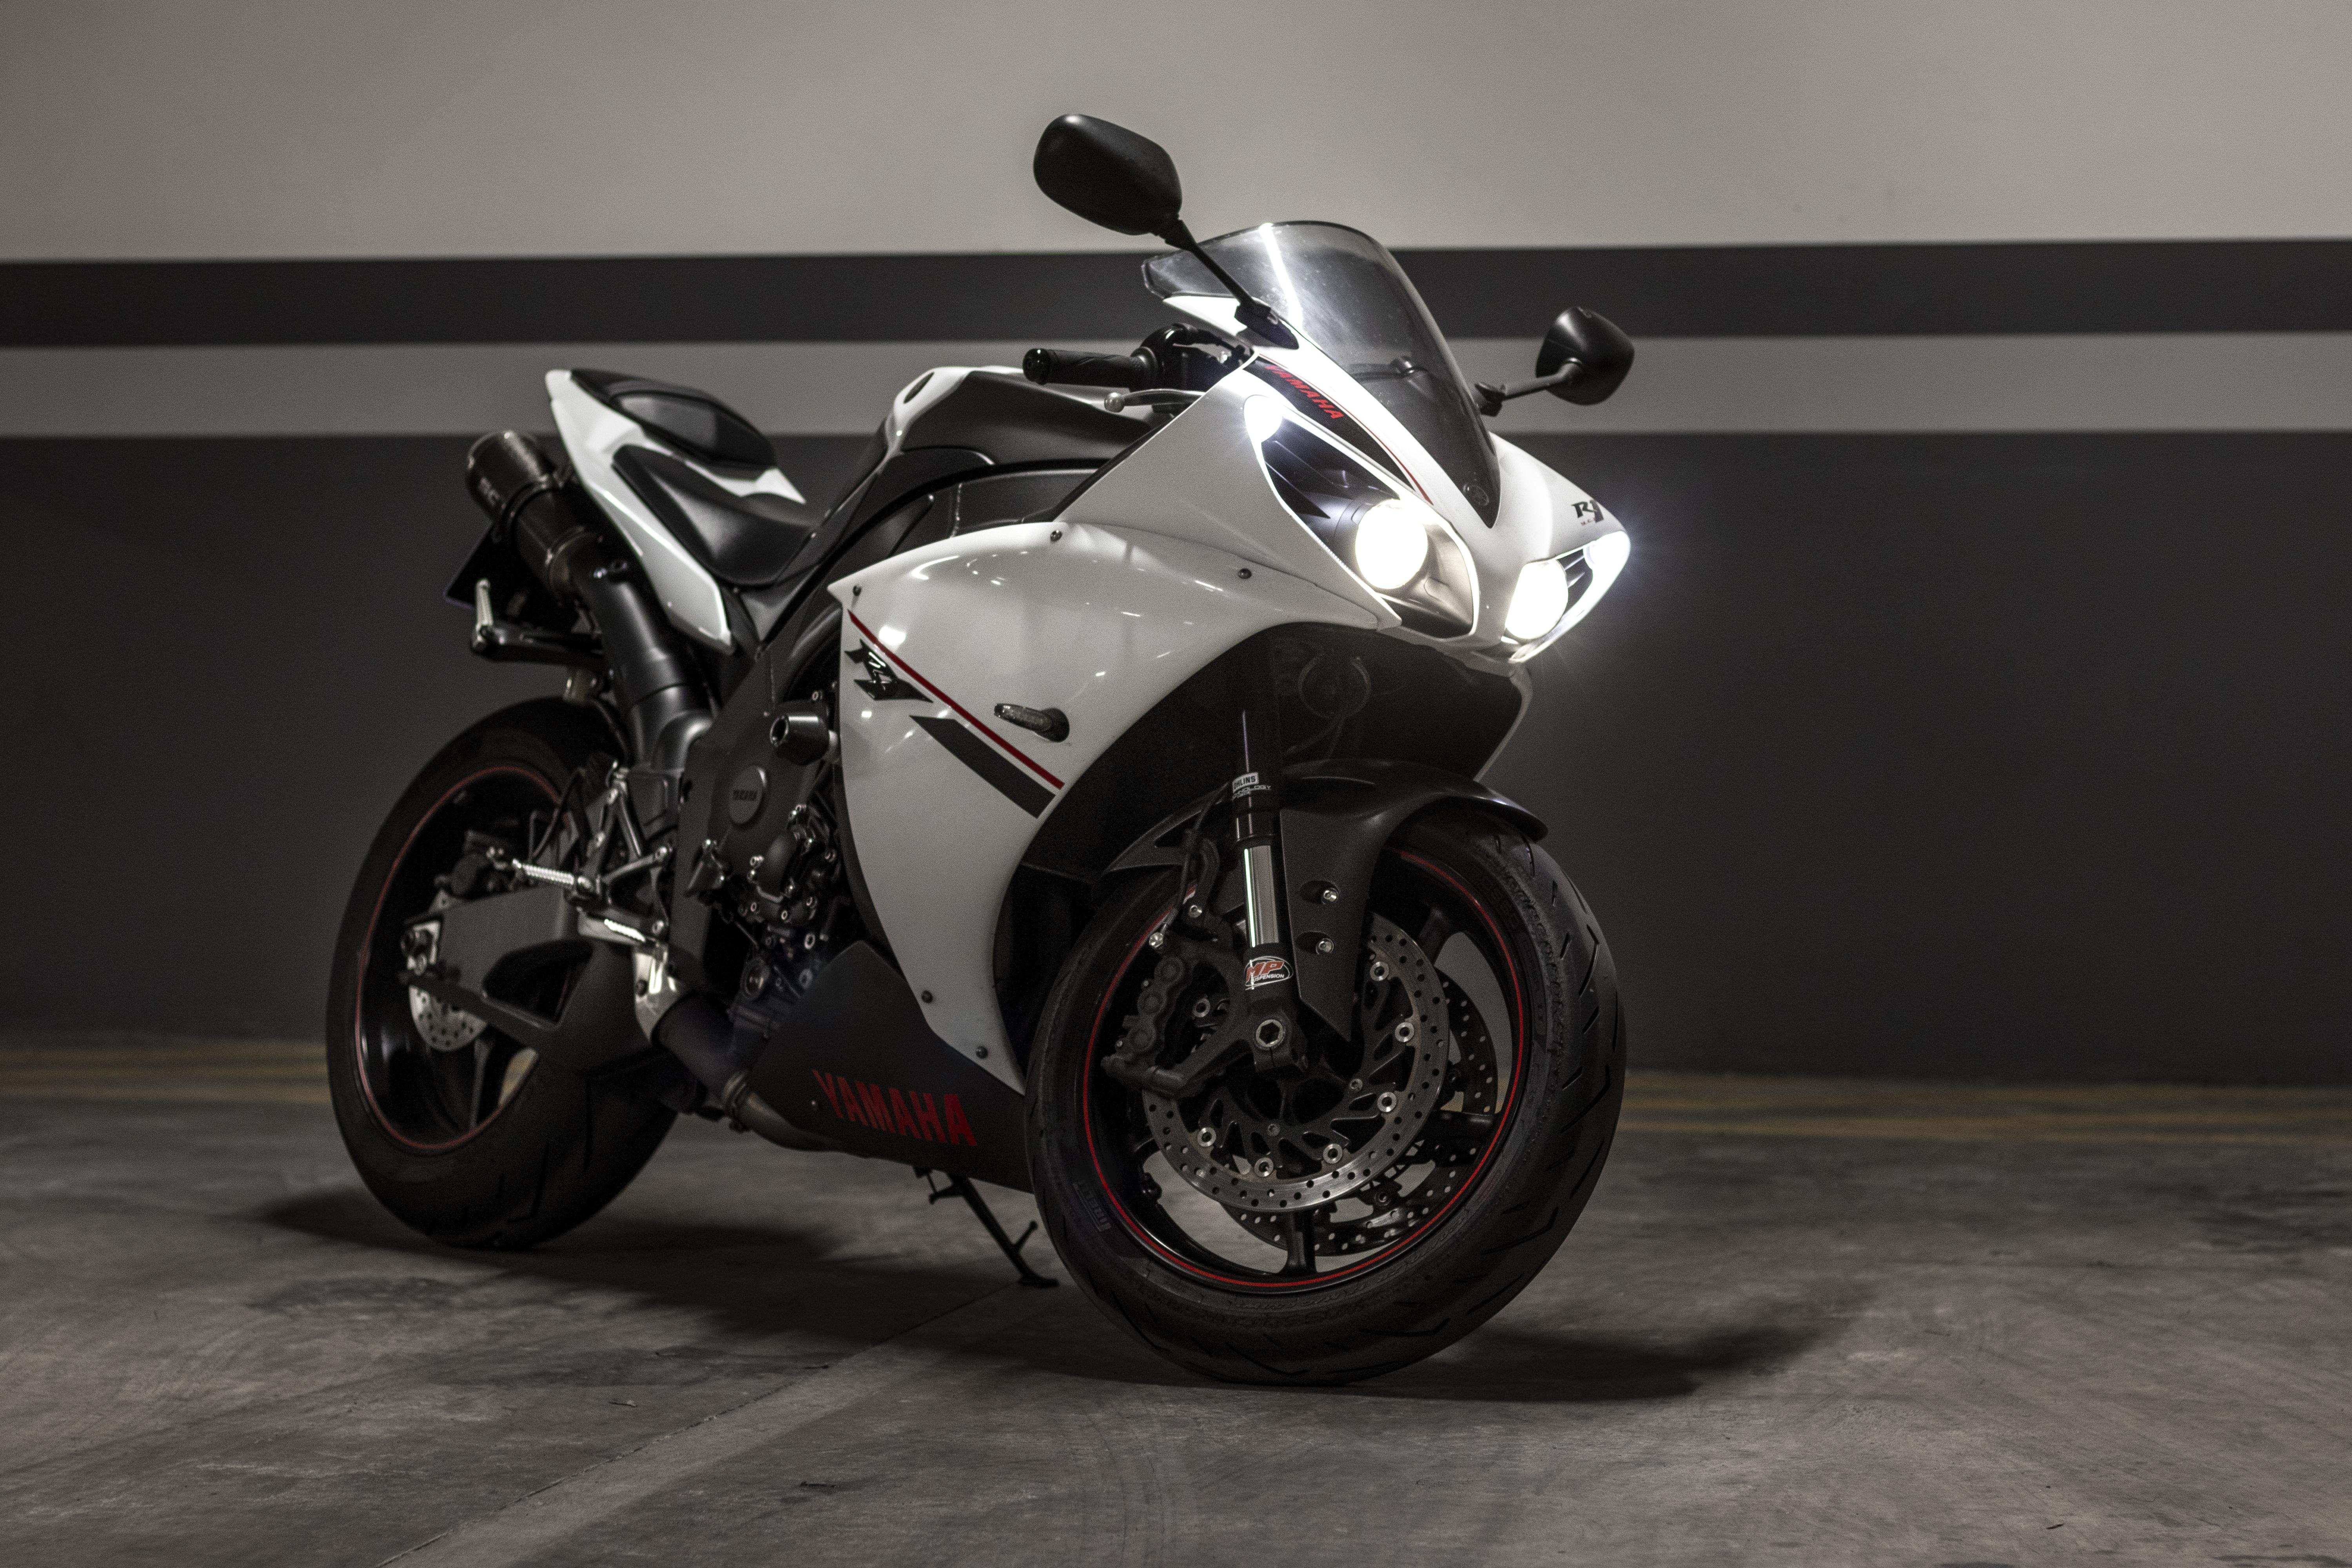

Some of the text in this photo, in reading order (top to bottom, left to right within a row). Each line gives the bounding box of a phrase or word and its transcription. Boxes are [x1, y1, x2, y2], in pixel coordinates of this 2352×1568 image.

[1265, 365, 1344, 419] YAMAHA
[1245, 960, 1285, 984] MP
[811, 1069, 978, 1146] YAMAHA
[1072, 1180, 1112, 1232] PIRELLI
